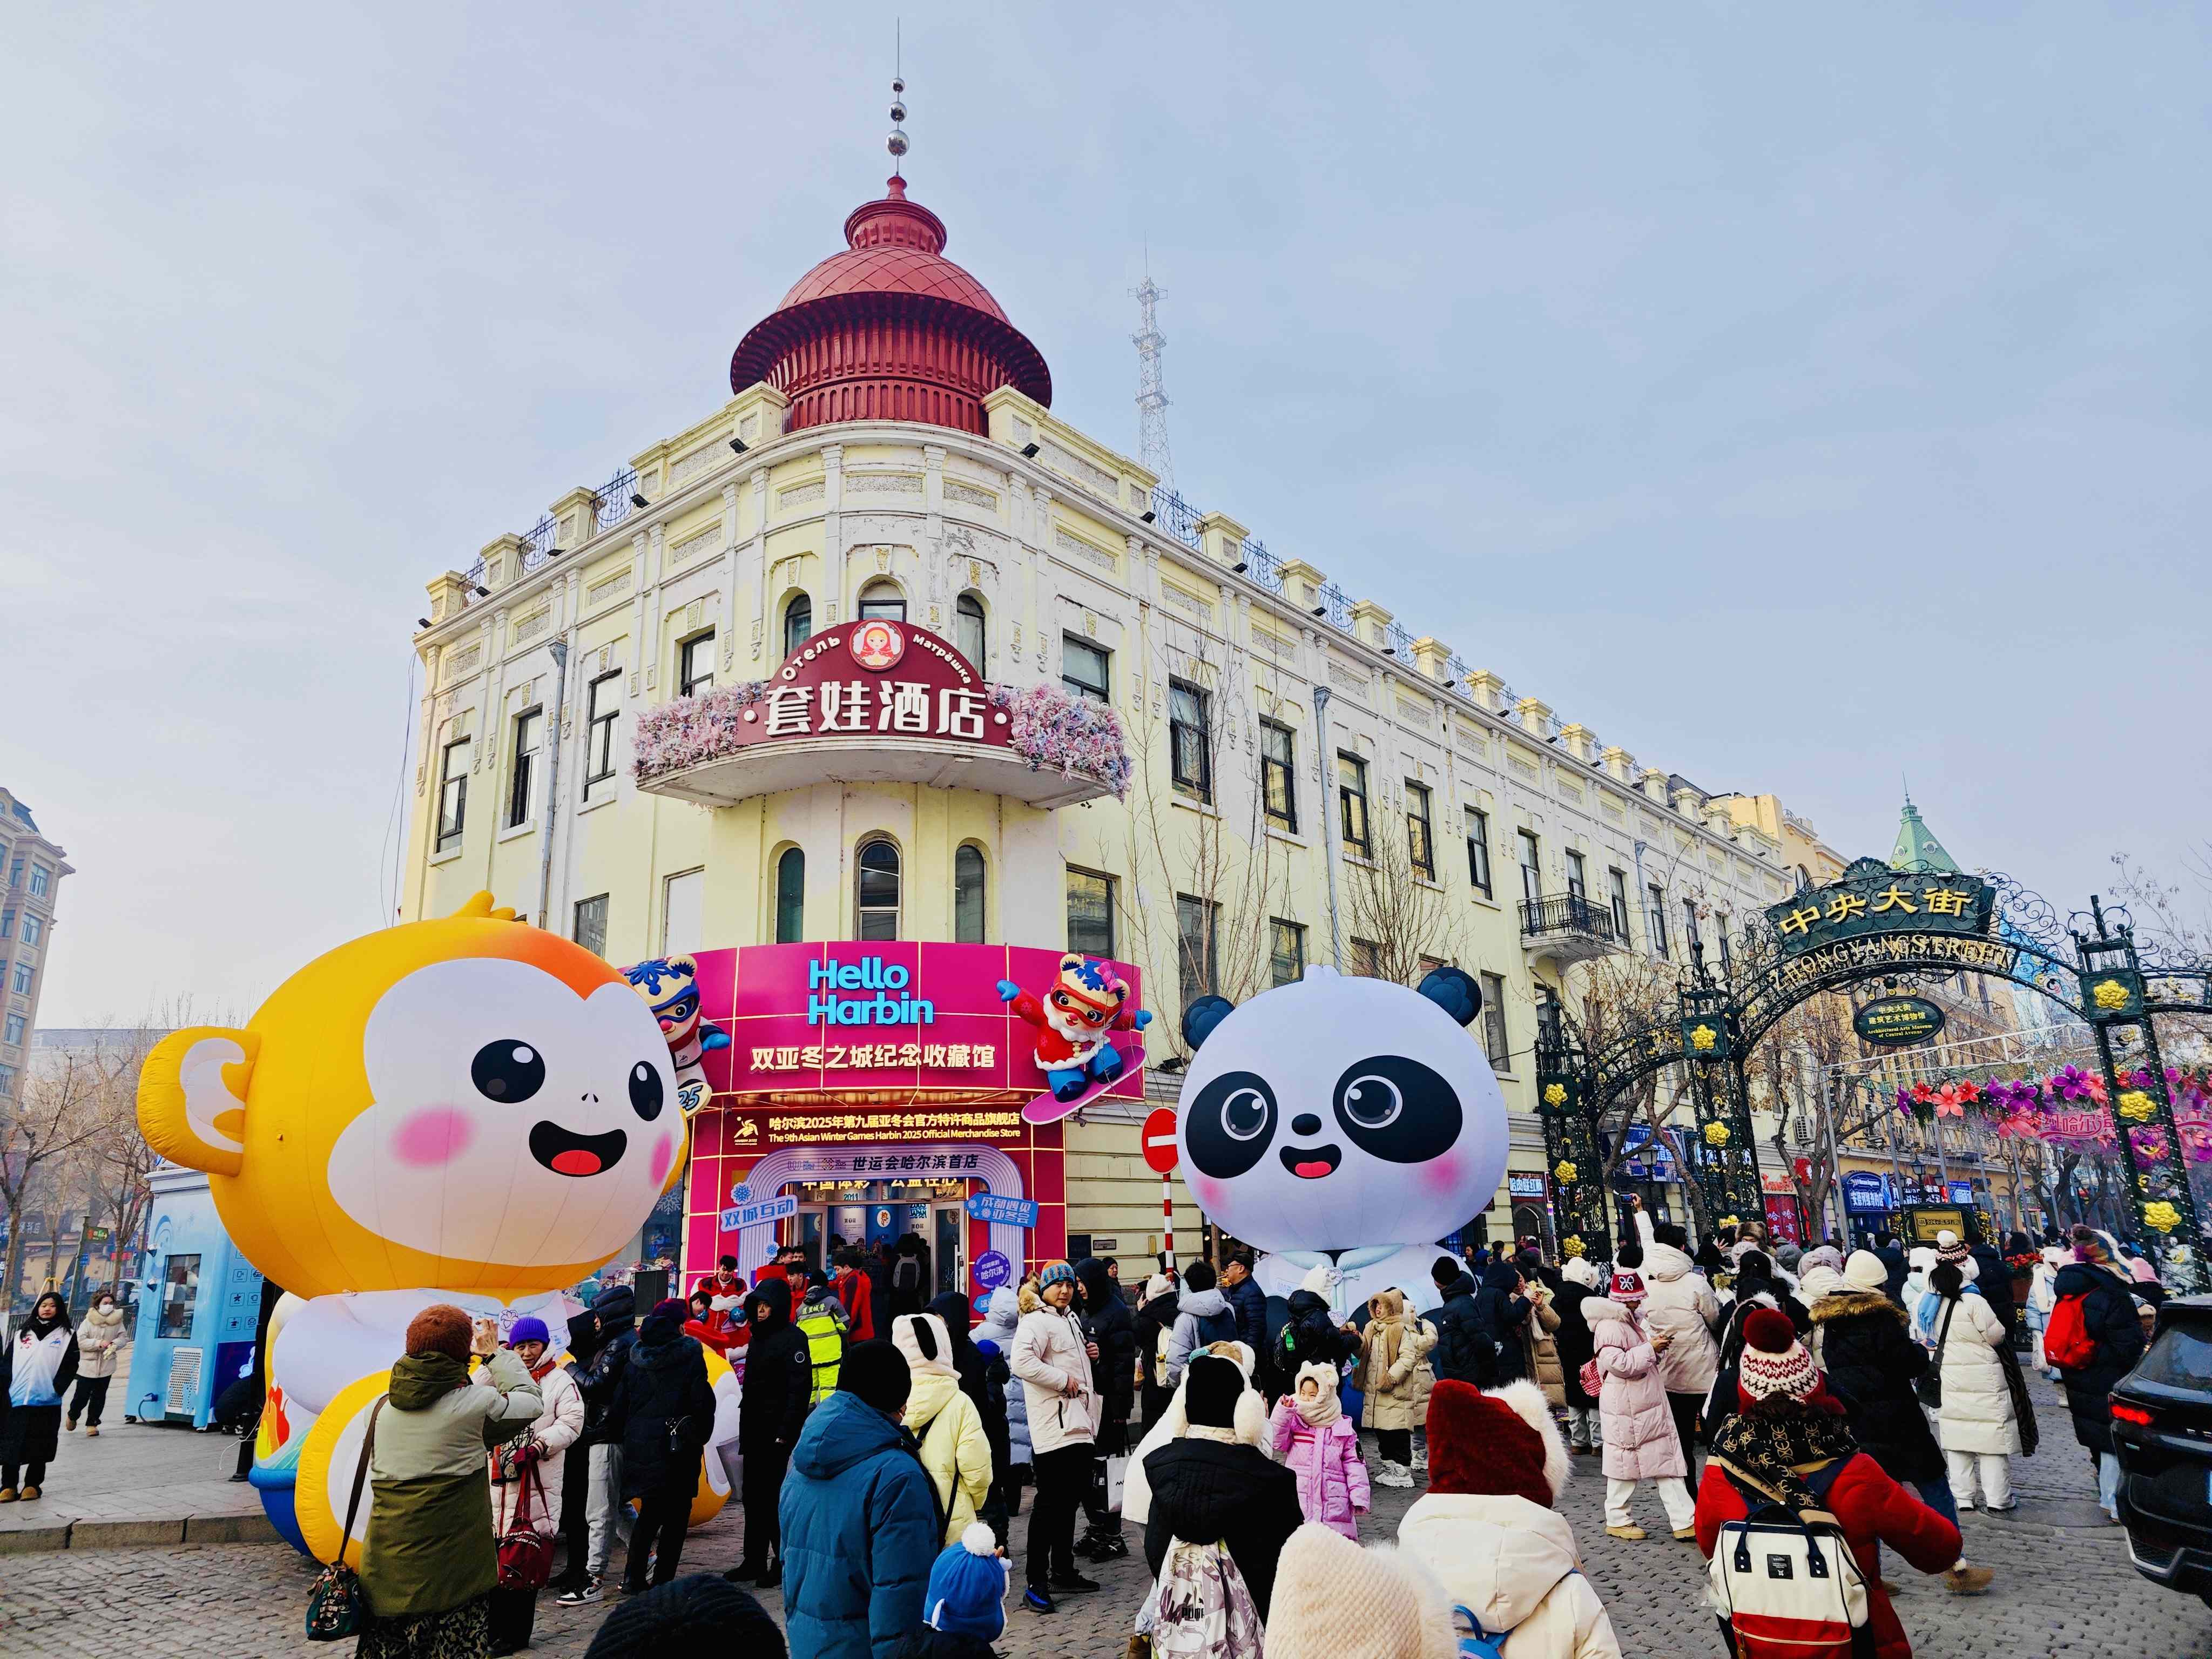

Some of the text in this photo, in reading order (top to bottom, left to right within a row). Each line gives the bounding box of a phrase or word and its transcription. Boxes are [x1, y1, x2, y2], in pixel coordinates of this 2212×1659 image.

[913, 634, 972, 684] Матрёшка
[764, 680, 986, 739] 套娃酒店
[1779, 884, 1974, 936] 中央大街
[808, 956, 909, 990] Hello
[808, 992, 934, 1026] Harbin
[1868, 1011, 1926, 1025] 建筑艺术博物馆
[1878, 1003, 1912, 1014] 中央大街
[750, 1043, 996, 1072] 双亚冬之城纪念收藏馆
[678, 1085, 704, 1111] 25
[768, 1112, 1020, 1130] 哈尔滨2025年第九届亚冬会官方特许商品旗舰店
[768, 1129, 1021, 1143] The 9th Asian Winter Games Harbin 2025 Official Merchandise Store
[853, 1154, 979, 1171] 世运会哈尔滨首店
[724, 1199, 793, 1228] 双城互动
[981, 1196, 1031, 1213] 成都遇见
[992, 1209, 1030, 1224] 亚冬会
[981, 1265, 1004, 1280] 哈尔滨
